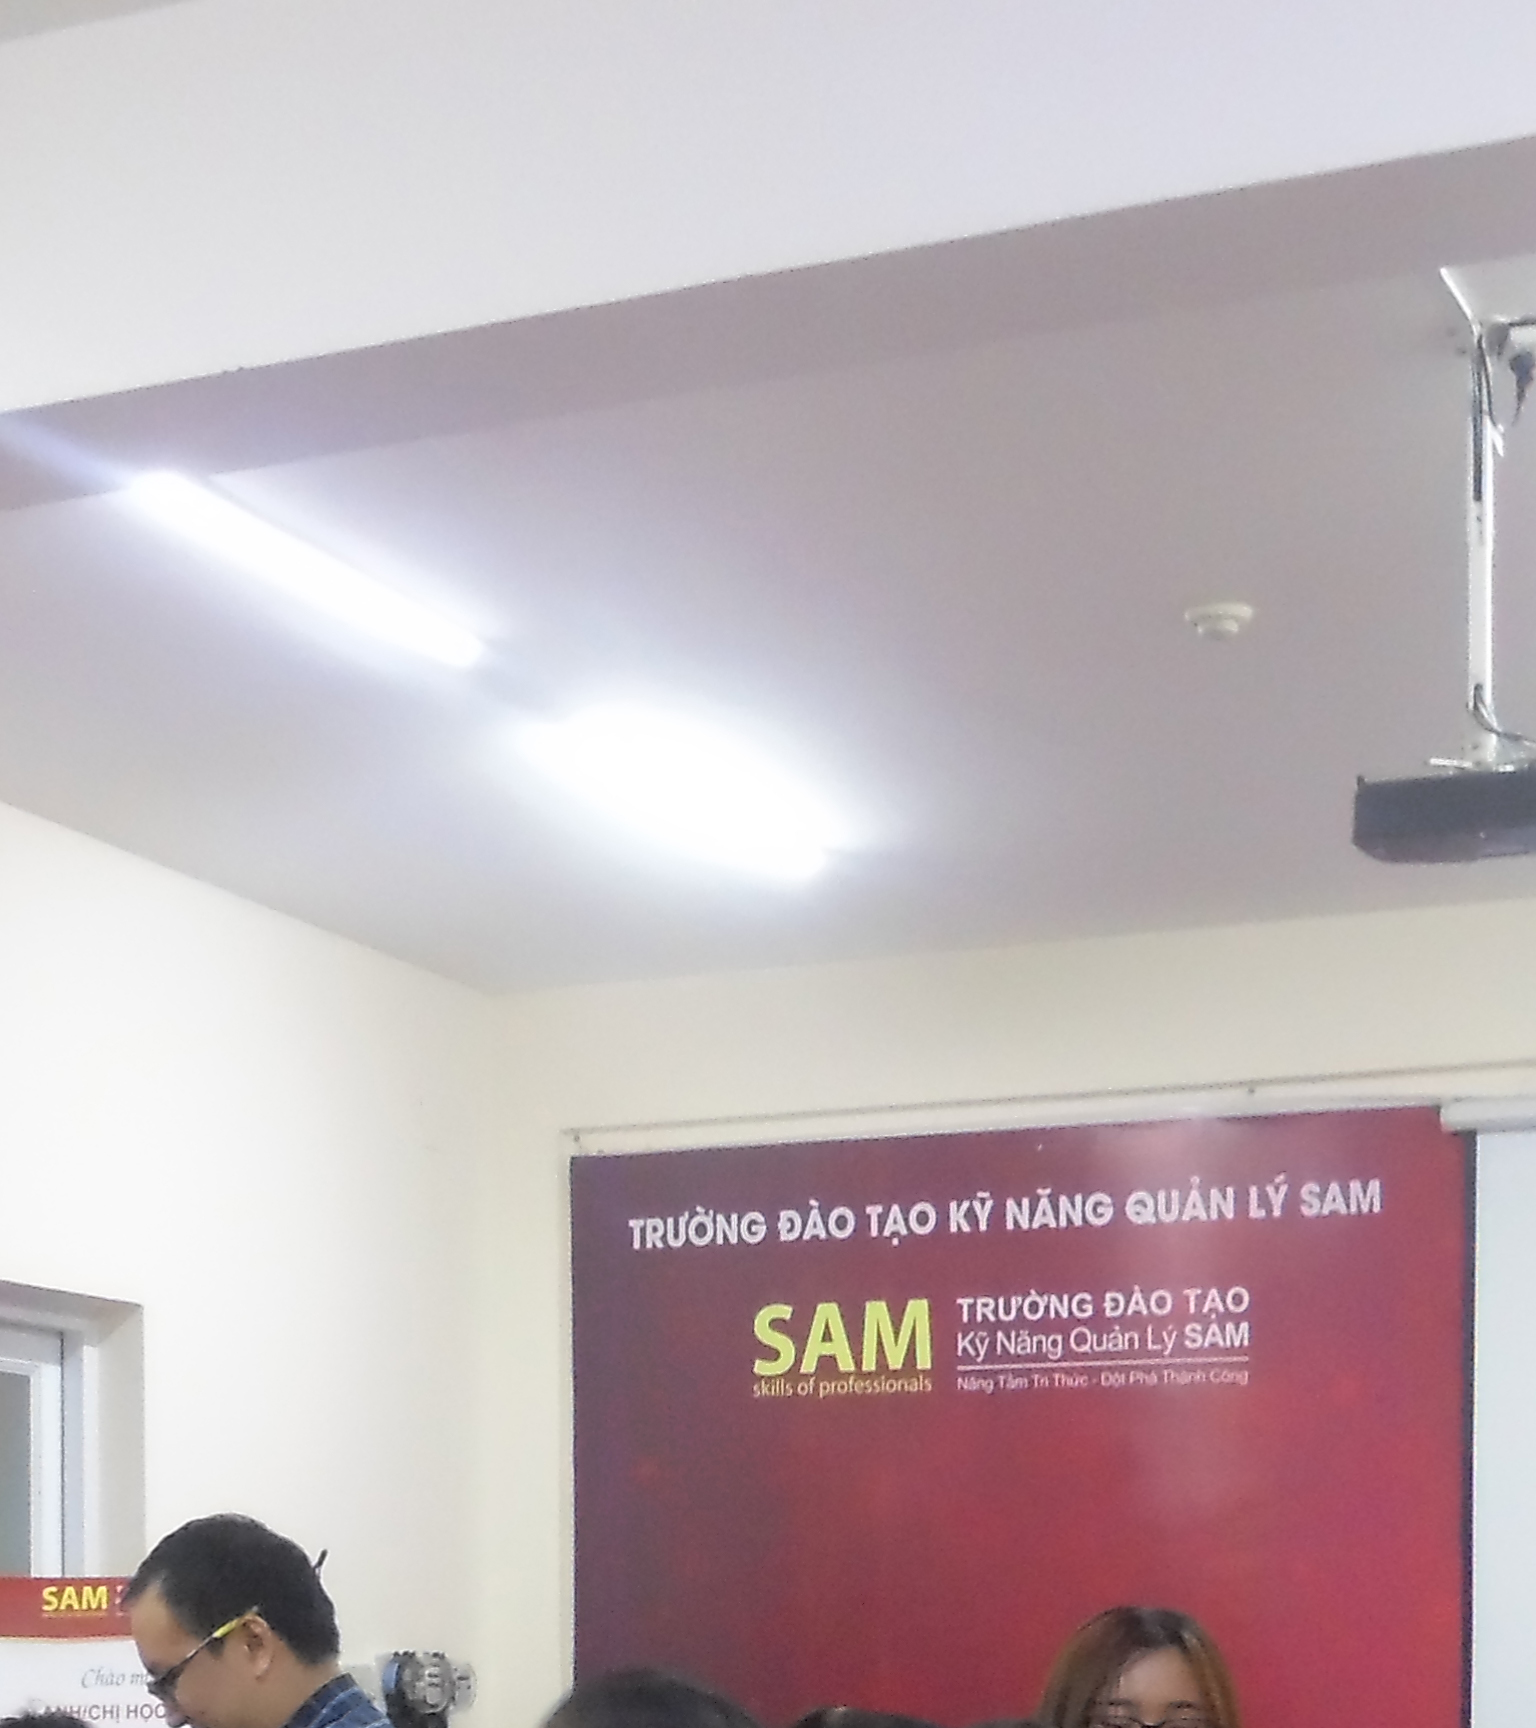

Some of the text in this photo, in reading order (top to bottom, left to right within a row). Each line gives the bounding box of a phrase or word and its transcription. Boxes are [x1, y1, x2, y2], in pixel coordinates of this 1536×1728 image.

[628, 1173, 1382, 1250] TRƯỜNG ĐÀO TẠO KỸ NĂNG QUẢN LÝ SAM
[956, 1285, 1250, 1323] TRƯỜNG ĐÀO TẠO
[753, 1298, 932, 1375] SAM
[956, 1321, 1250, 1362] Kỹ Năng Quản Lý SAM
[752, 1374, 933, 1399] skills of professionals
[42, 1585, 109, 1612] SAM
